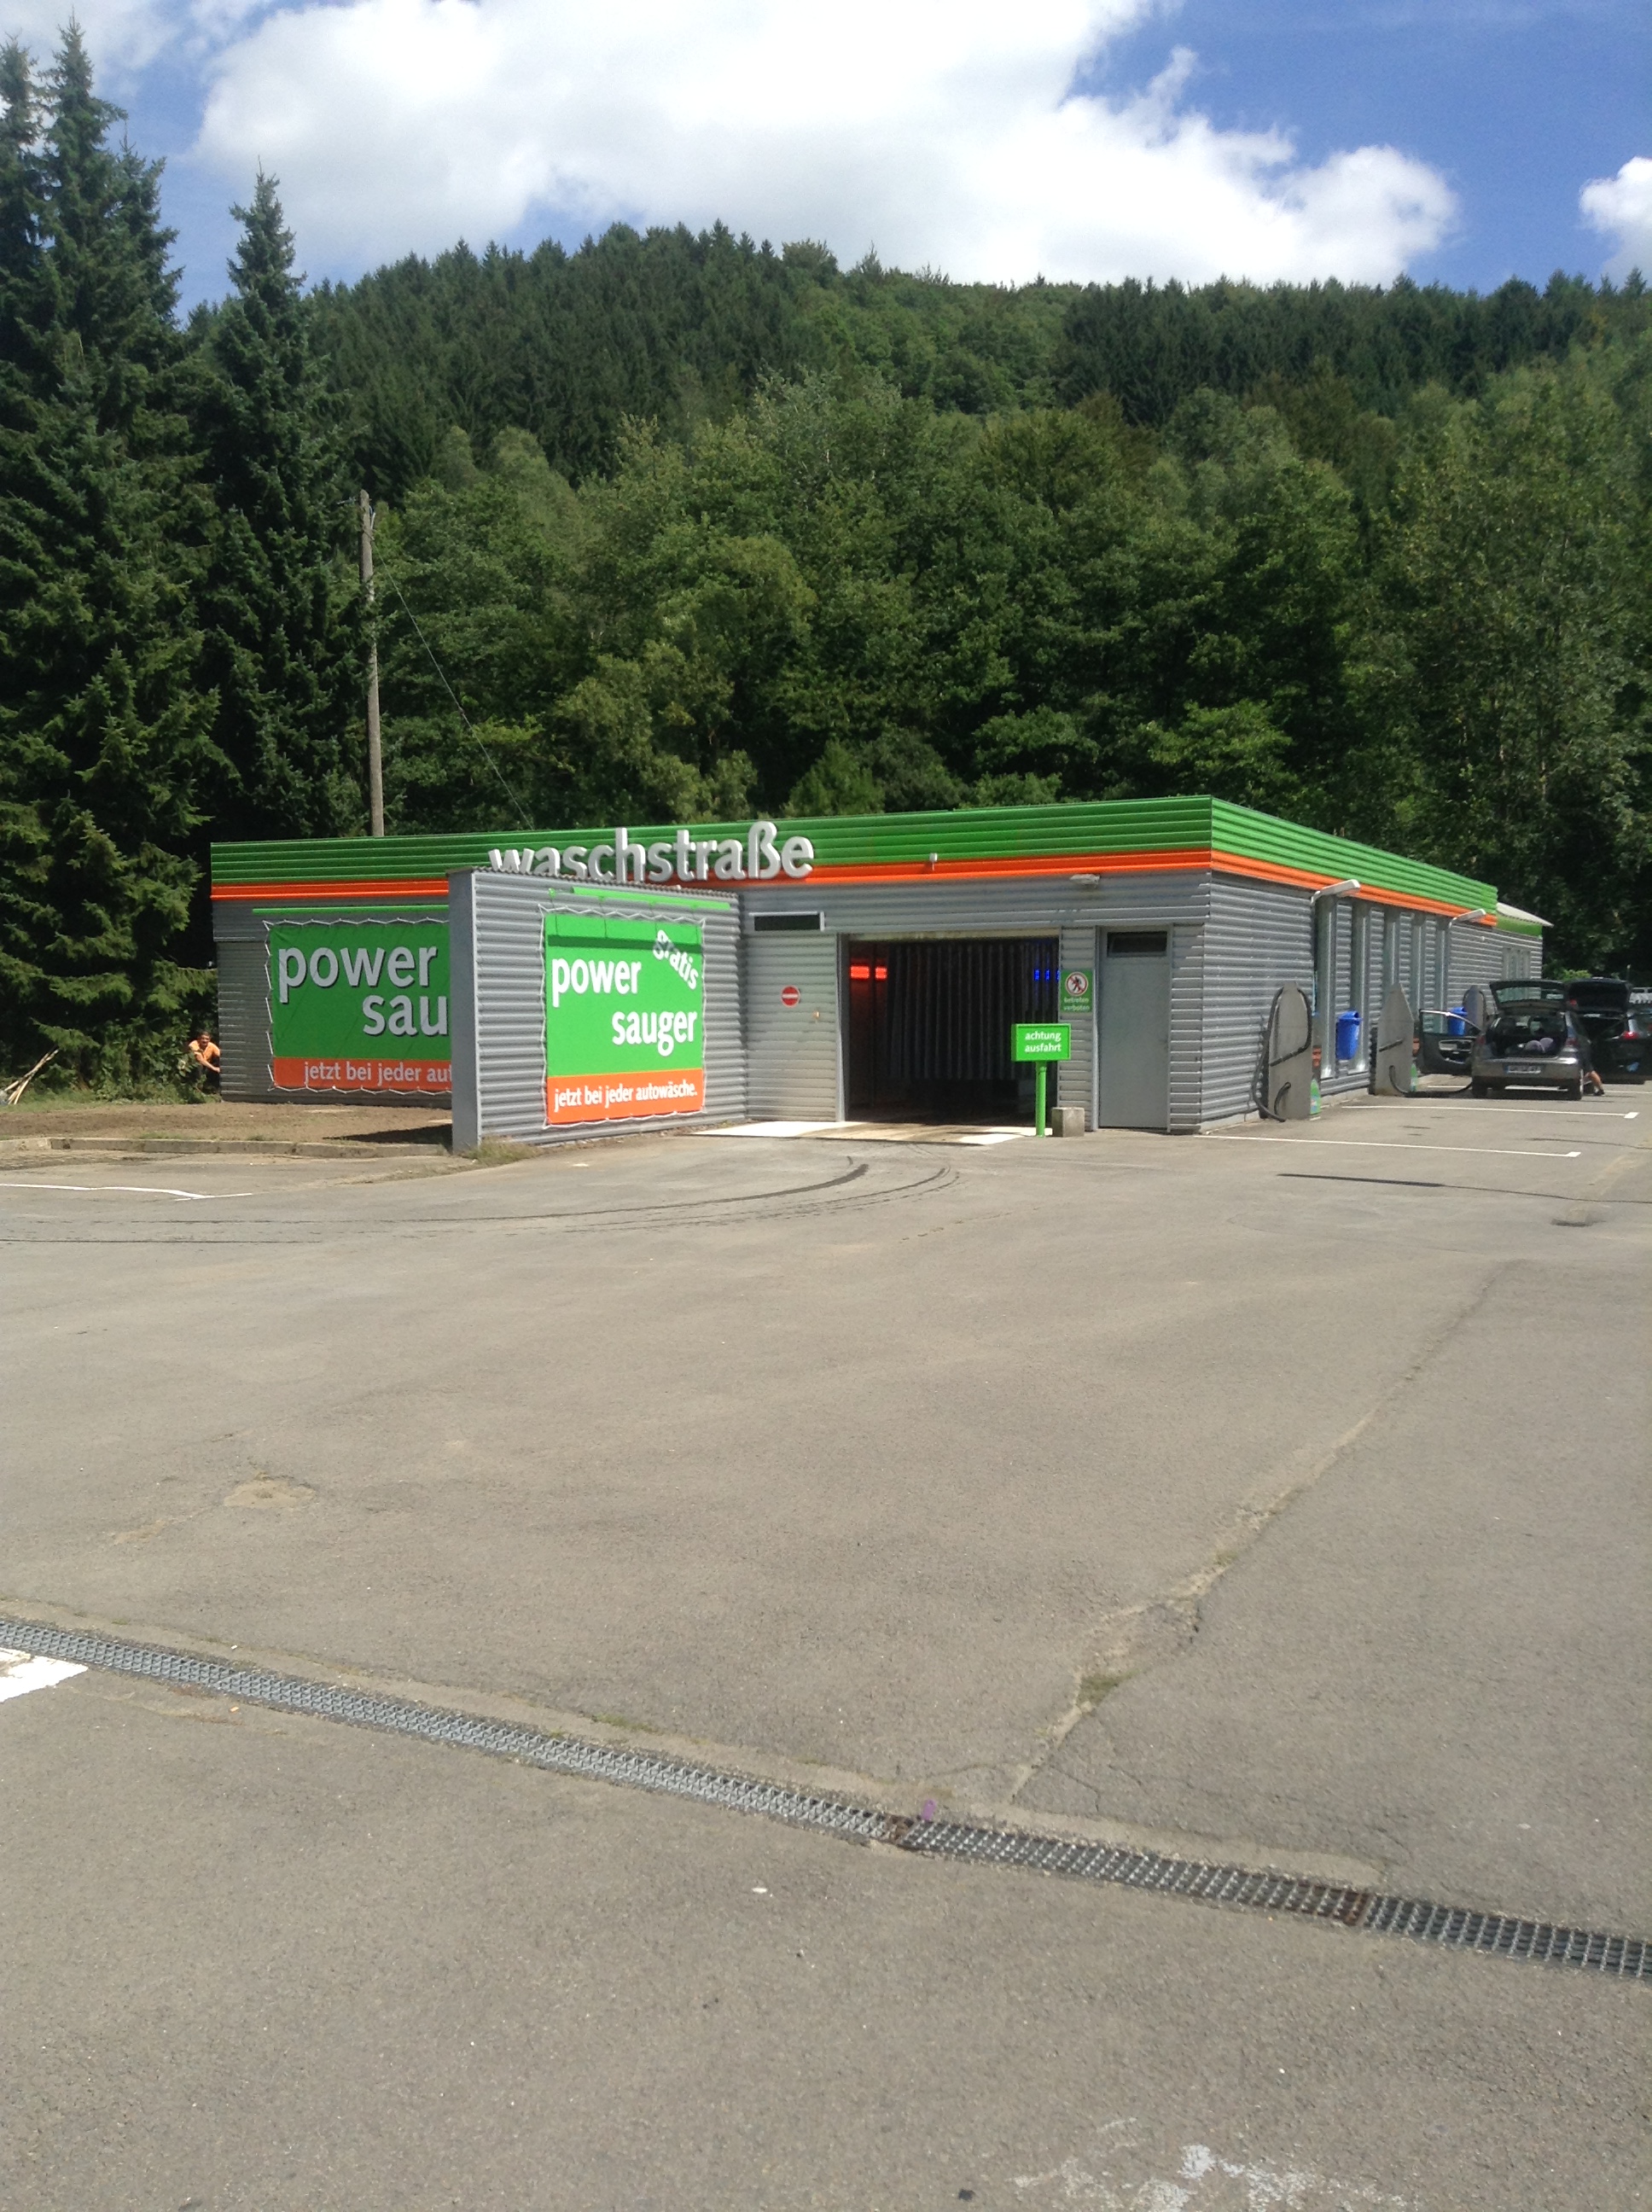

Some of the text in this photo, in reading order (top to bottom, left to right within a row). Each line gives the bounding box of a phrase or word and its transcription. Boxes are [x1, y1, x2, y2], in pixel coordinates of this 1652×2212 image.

[488, 821, 813, 882] waschstraße
[278, 946, 438, 1004] power
[653, 929, 699, 990] gratis
[552, 958, 642, 1008] power
[363, 994, 448, 1035] sau
[611, 1011, 698, 1057] sauger
[1025, 1031, 1062, 1041] achtung
[1025, 1043, 1062, 1052] ausfahrt
[304, 1062, 341, 1085] jetzt
[346, 1061, 372, 1081] bei
[377, 1062, 422, 1086] jeder
[554, 1079, 698, 1113] jetzt bei jeder autowäsche.
